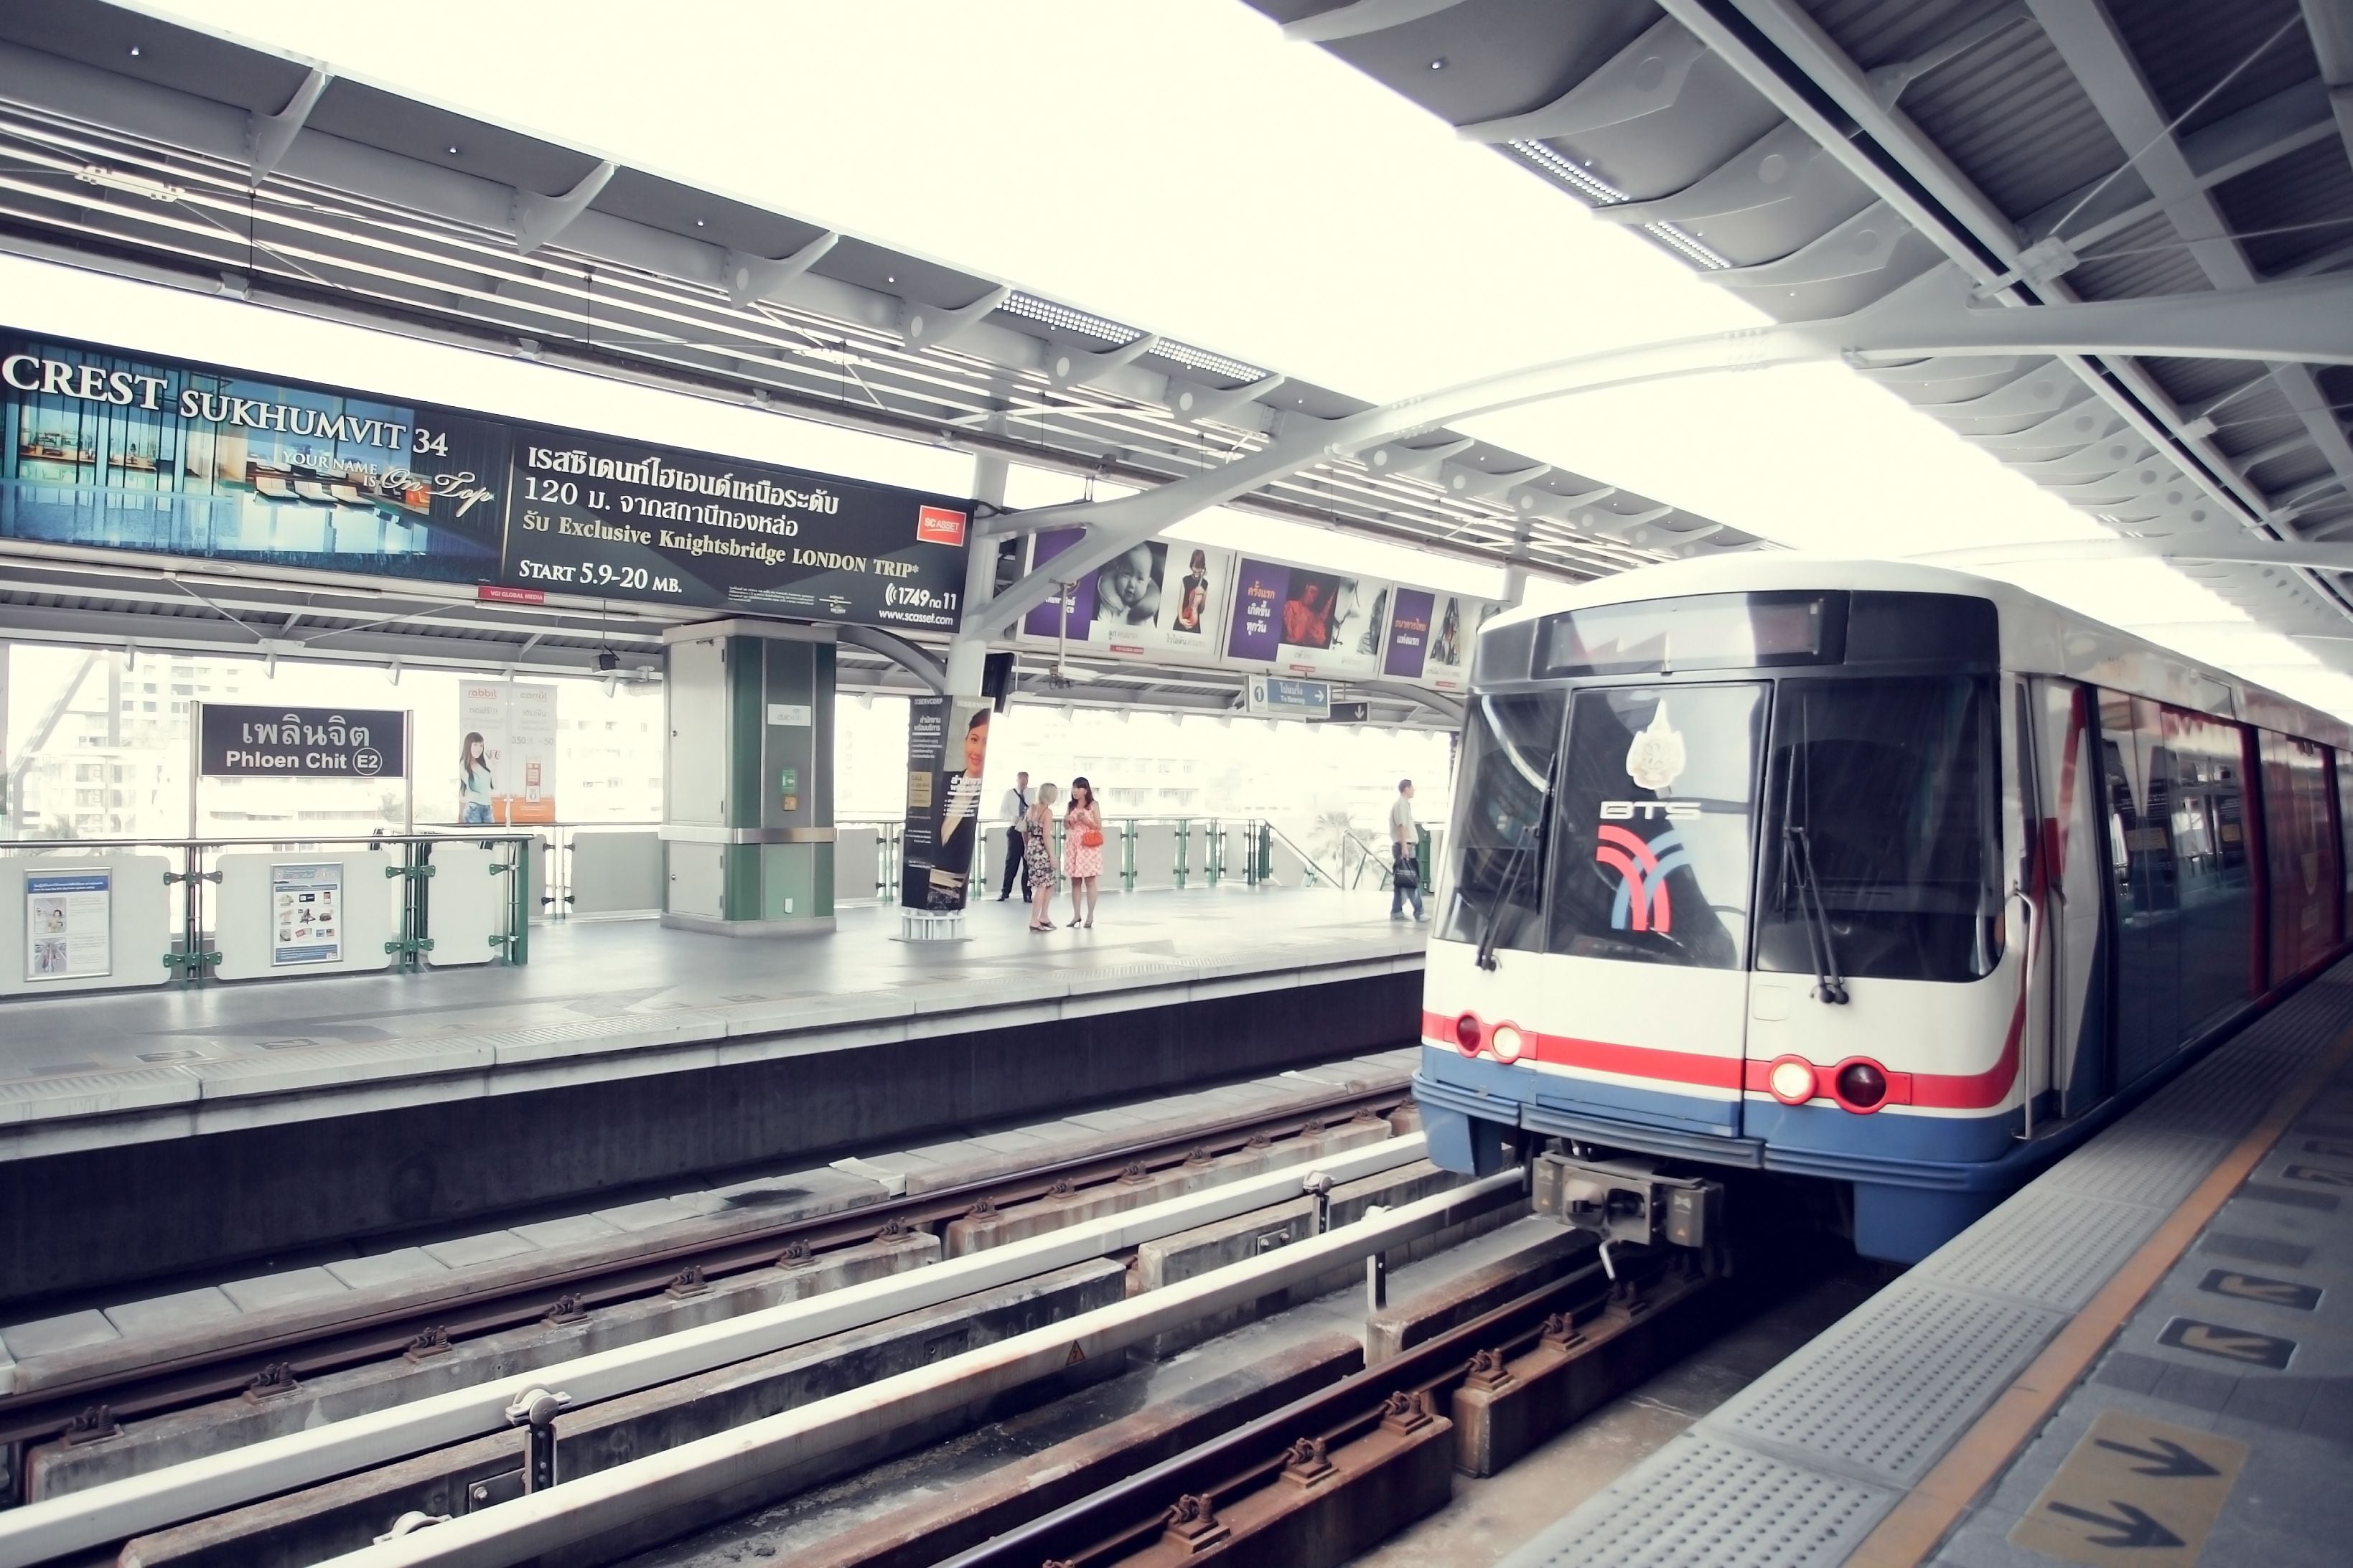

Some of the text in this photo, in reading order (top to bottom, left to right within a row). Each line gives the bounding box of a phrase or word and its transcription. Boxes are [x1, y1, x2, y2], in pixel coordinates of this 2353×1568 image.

[2, 355, 448, 457] CREST SUKHUMVIT 34
[284, 451, 378, 476] YOUR NAME
[363, 468, 492, 517] IS On Top
[525, 476, 579, 505] 120
[588, 490, 611, 510] ม.
[936, 520, 960, 530] ASSET
[523, 510, 551, 532] รับ
[558, 515, 651, 545] Exclusive
[658, 530, 786, 565] Knightsbridge
[792, 548, 868, 573] LONDON
[519, 560, 683, 593] START 5.9-20 MB.
[897, 587, 930, 608] 1749
[943, 592, 957, 611] 11
[1248, 581, 1276, 599] ครั้งแรก
[879, 609, 953, 626] www.scasset.com
[1246, 620, 1267, 636] ทุกวัน
[468, 688, 497, 698] rabbit
[1256, 687, 1262, 701] 1
[243, 713, 370, 747] เพลินจิต
[226, 751, 378, 769] Phloen Chit E2
[1599, 801, 1702, 820] BTS
